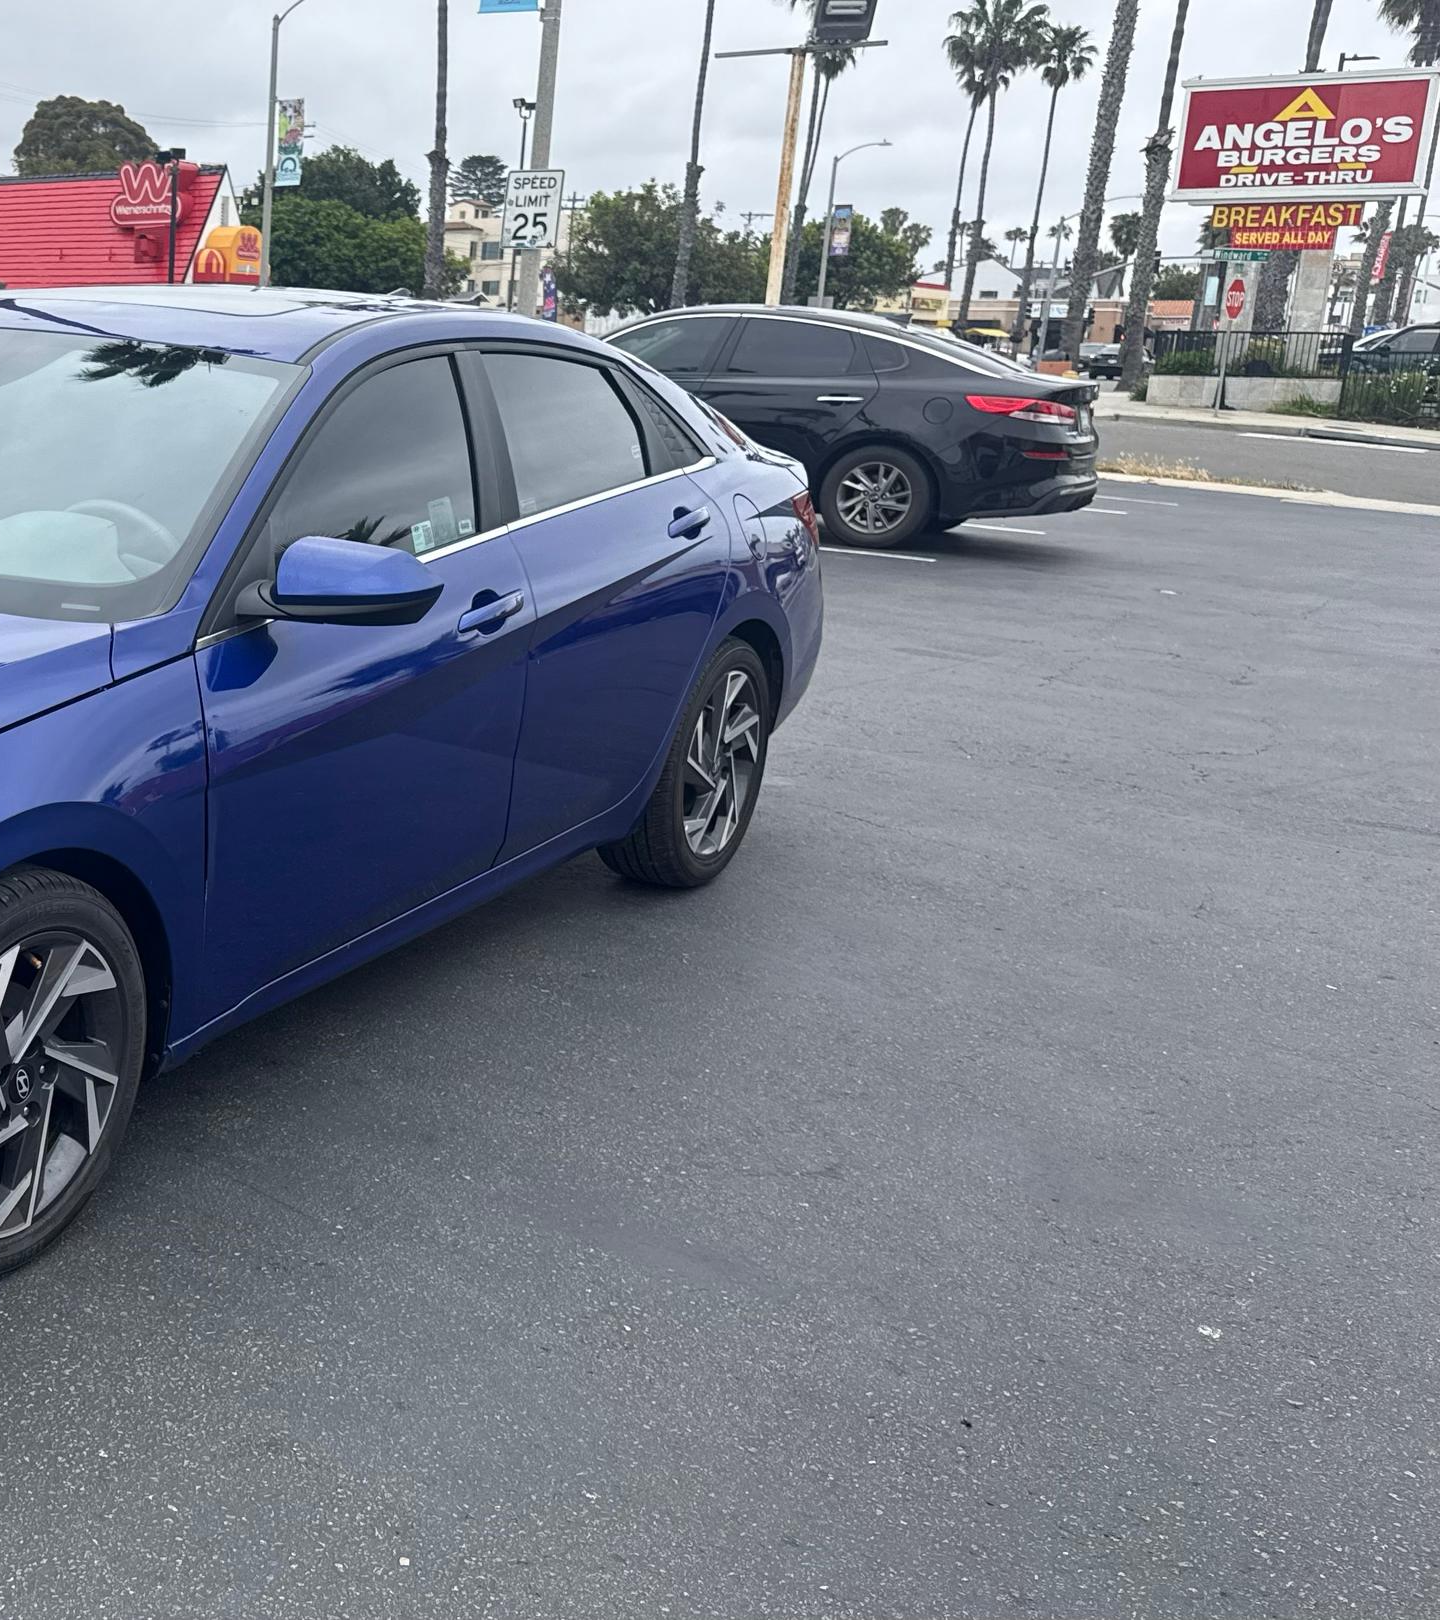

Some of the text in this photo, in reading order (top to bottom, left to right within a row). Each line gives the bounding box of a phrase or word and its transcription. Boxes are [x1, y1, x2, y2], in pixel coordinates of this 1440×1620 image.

[1194, 116, 1414, 151] ANGELO'S
[1216, 144, 1382, 168] BURGERS
[513, 176, 557, 190] SPEED
[1219, 169, 1374, 188] DRIVE-THRU
[515, 195, 551, 208] LIMIT
[115, 204, 172, 216] Wienerschnitz
[1212, 203, 1364, 229] BREAKFAST
[512, 212, 548, 241] 25
[1234, 230, 1333, 245] SERVED ALL DAY
[1214, 250, 1252, 261] Windward
[1227, 291, 1245, 307] STOP
